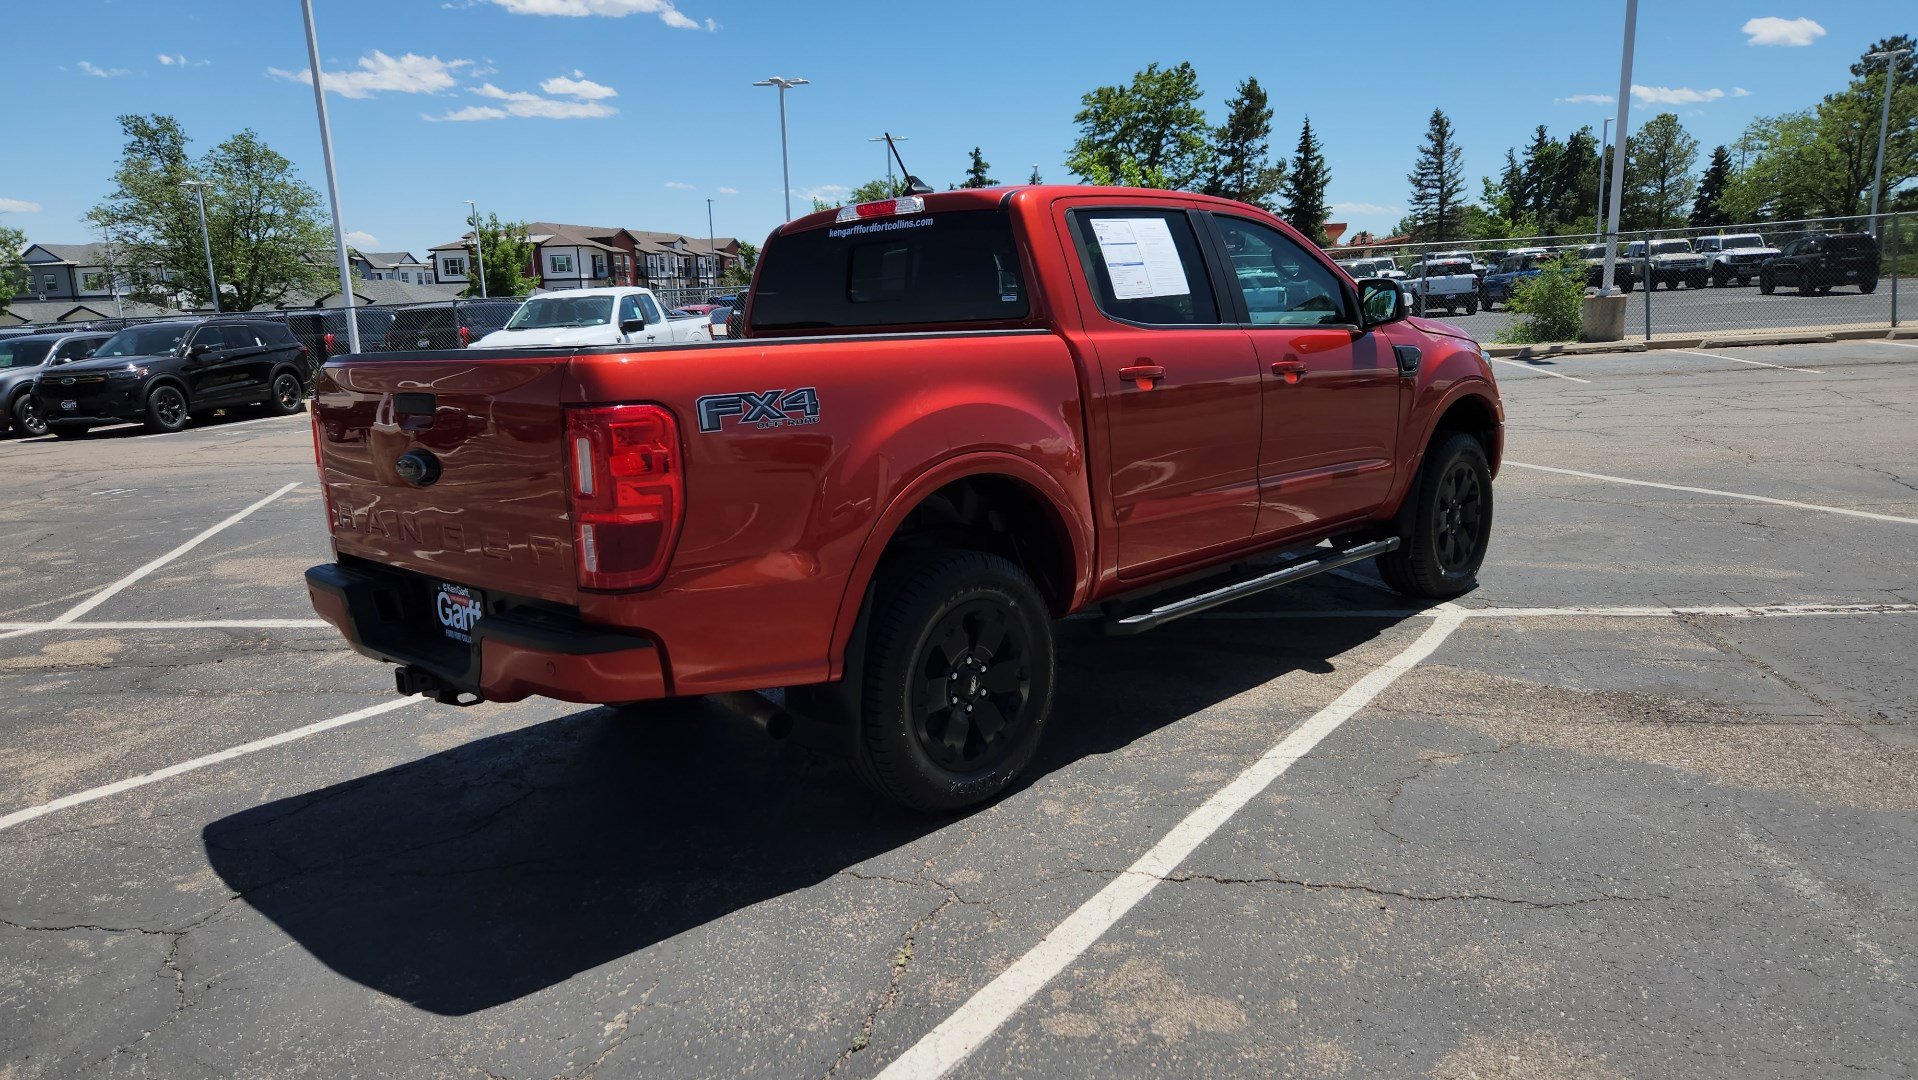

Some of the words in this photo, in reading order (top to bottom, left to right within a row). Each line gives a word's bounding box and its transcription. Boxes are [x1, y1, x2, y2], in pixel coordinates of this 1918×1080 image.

[829, 217, 934, 238] kengarfffordfortcollins.com
[695, 387, 821, 433] FX4
[756, 419, 783, 430] OFF
[787, 416, 820, 427] ROAD
[336, 502, 565, 571] RANGER
[438, 592, 481, 631] Garff
